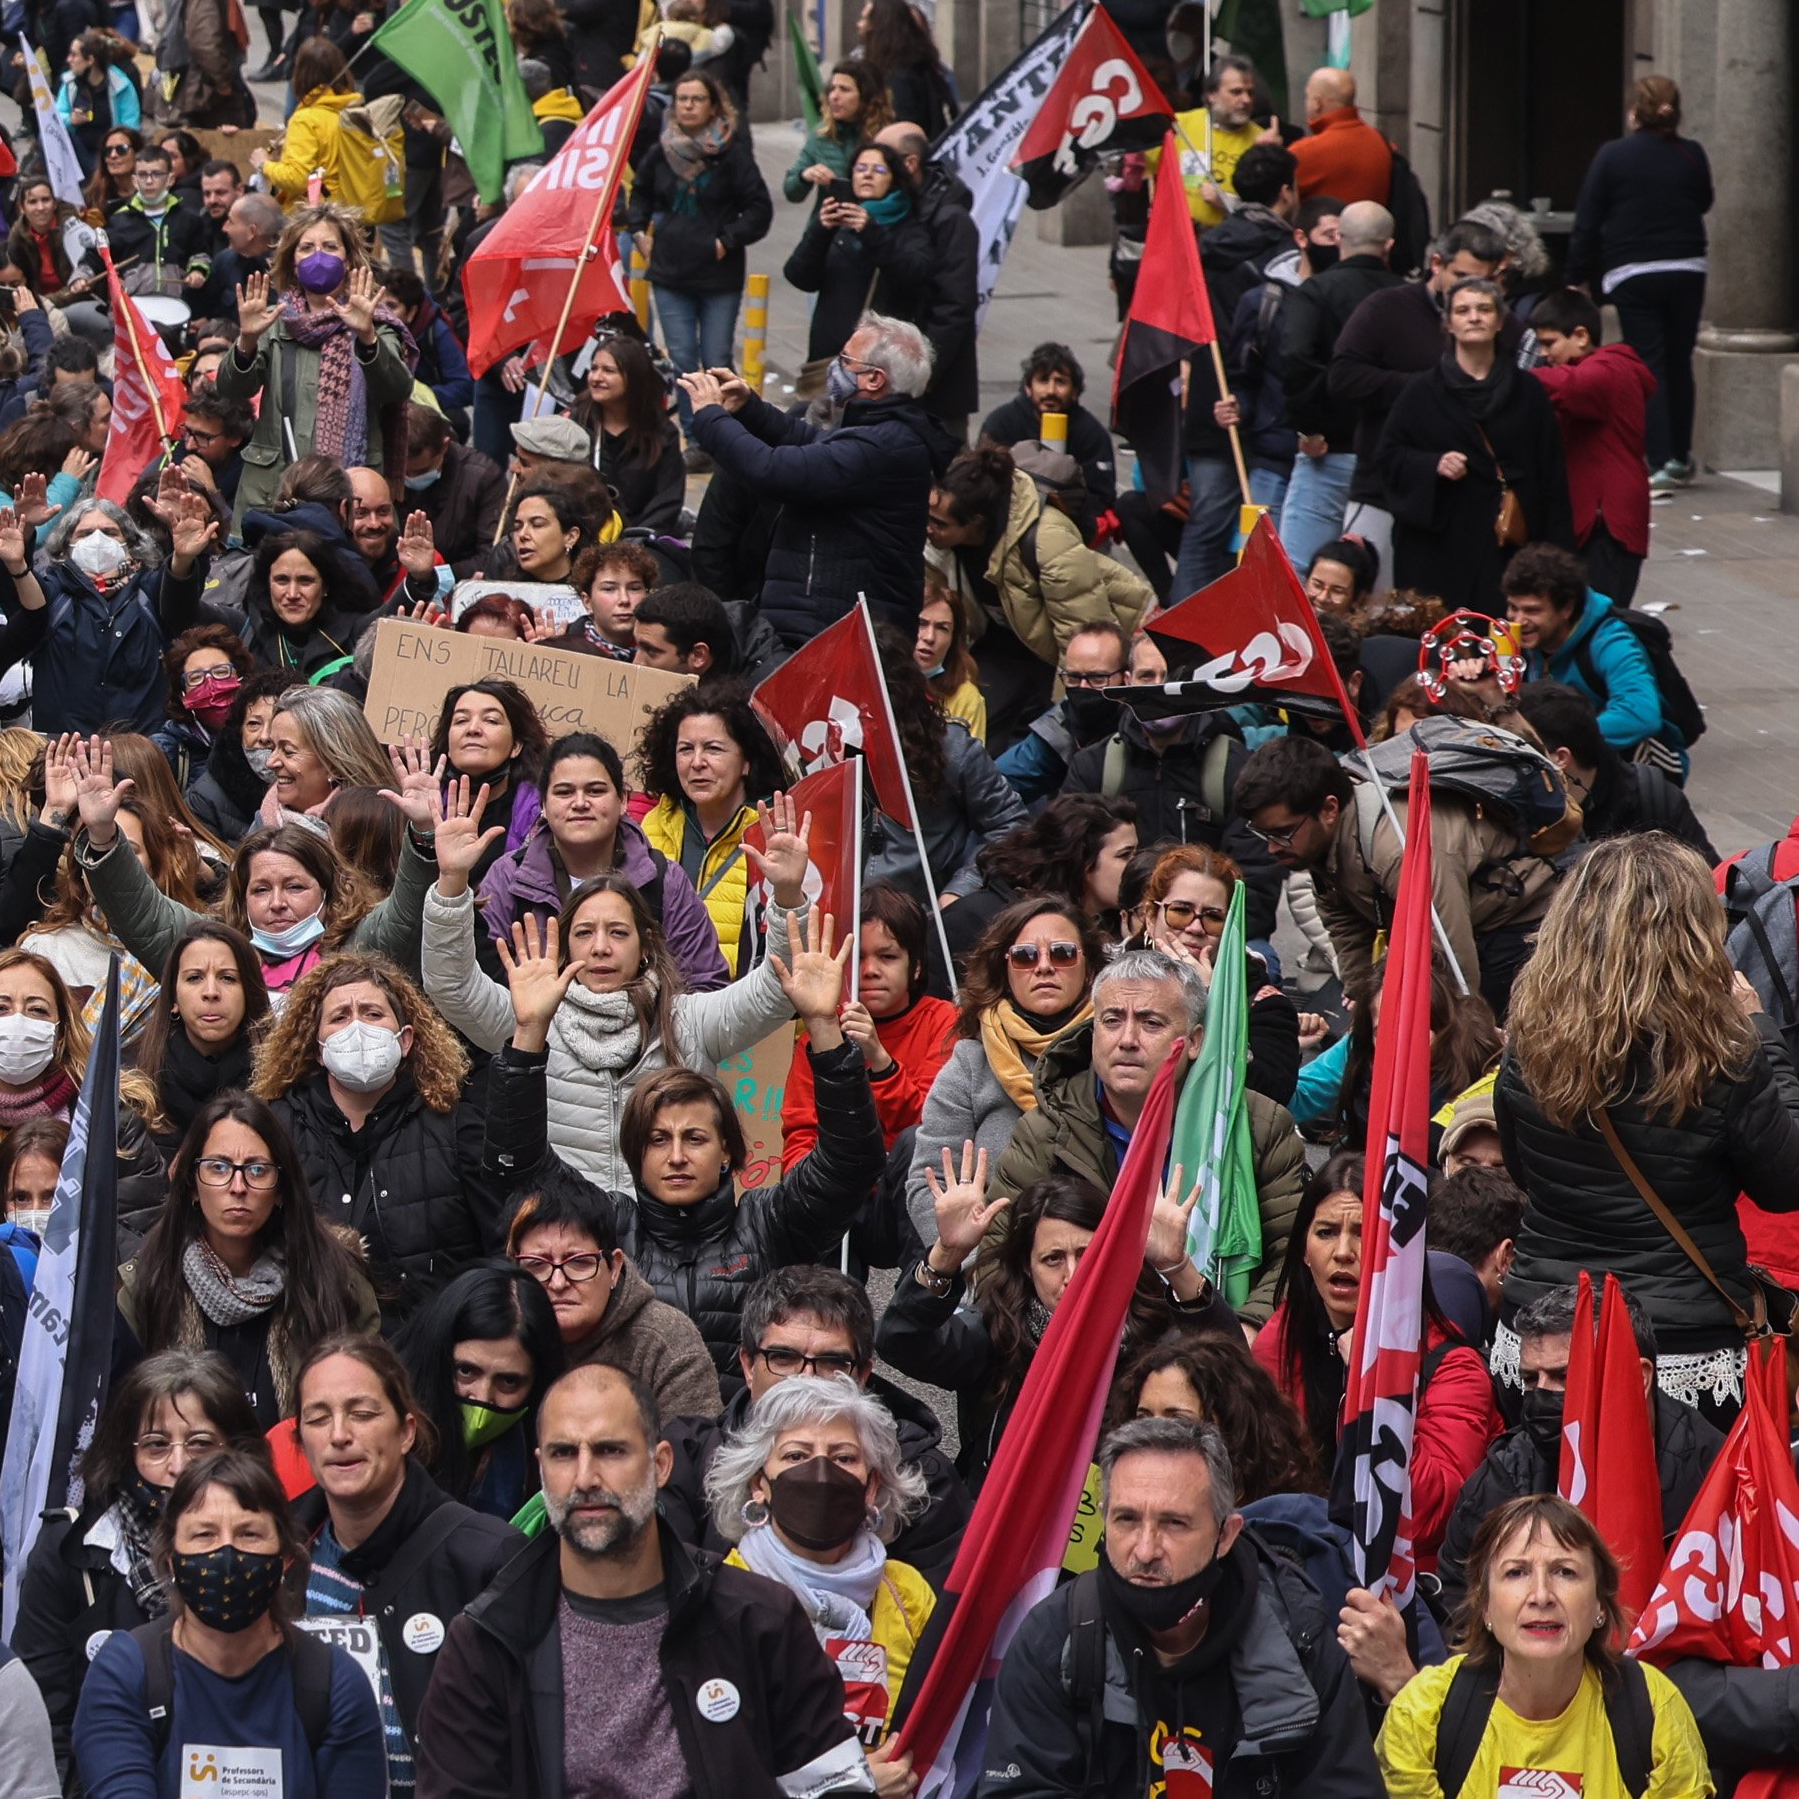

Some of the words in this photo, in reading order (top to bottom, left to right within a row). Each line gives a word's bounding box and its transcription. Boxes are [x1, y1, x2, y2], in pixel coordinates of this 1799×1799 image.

[396, 633, 452, 667] ENS
[482, 645, 582, 691] TALLAREU
[604, 674, 631, 700] LA
[222, 1766, 264, 1775] Professors
[222, 1776, 231, 1784] de
